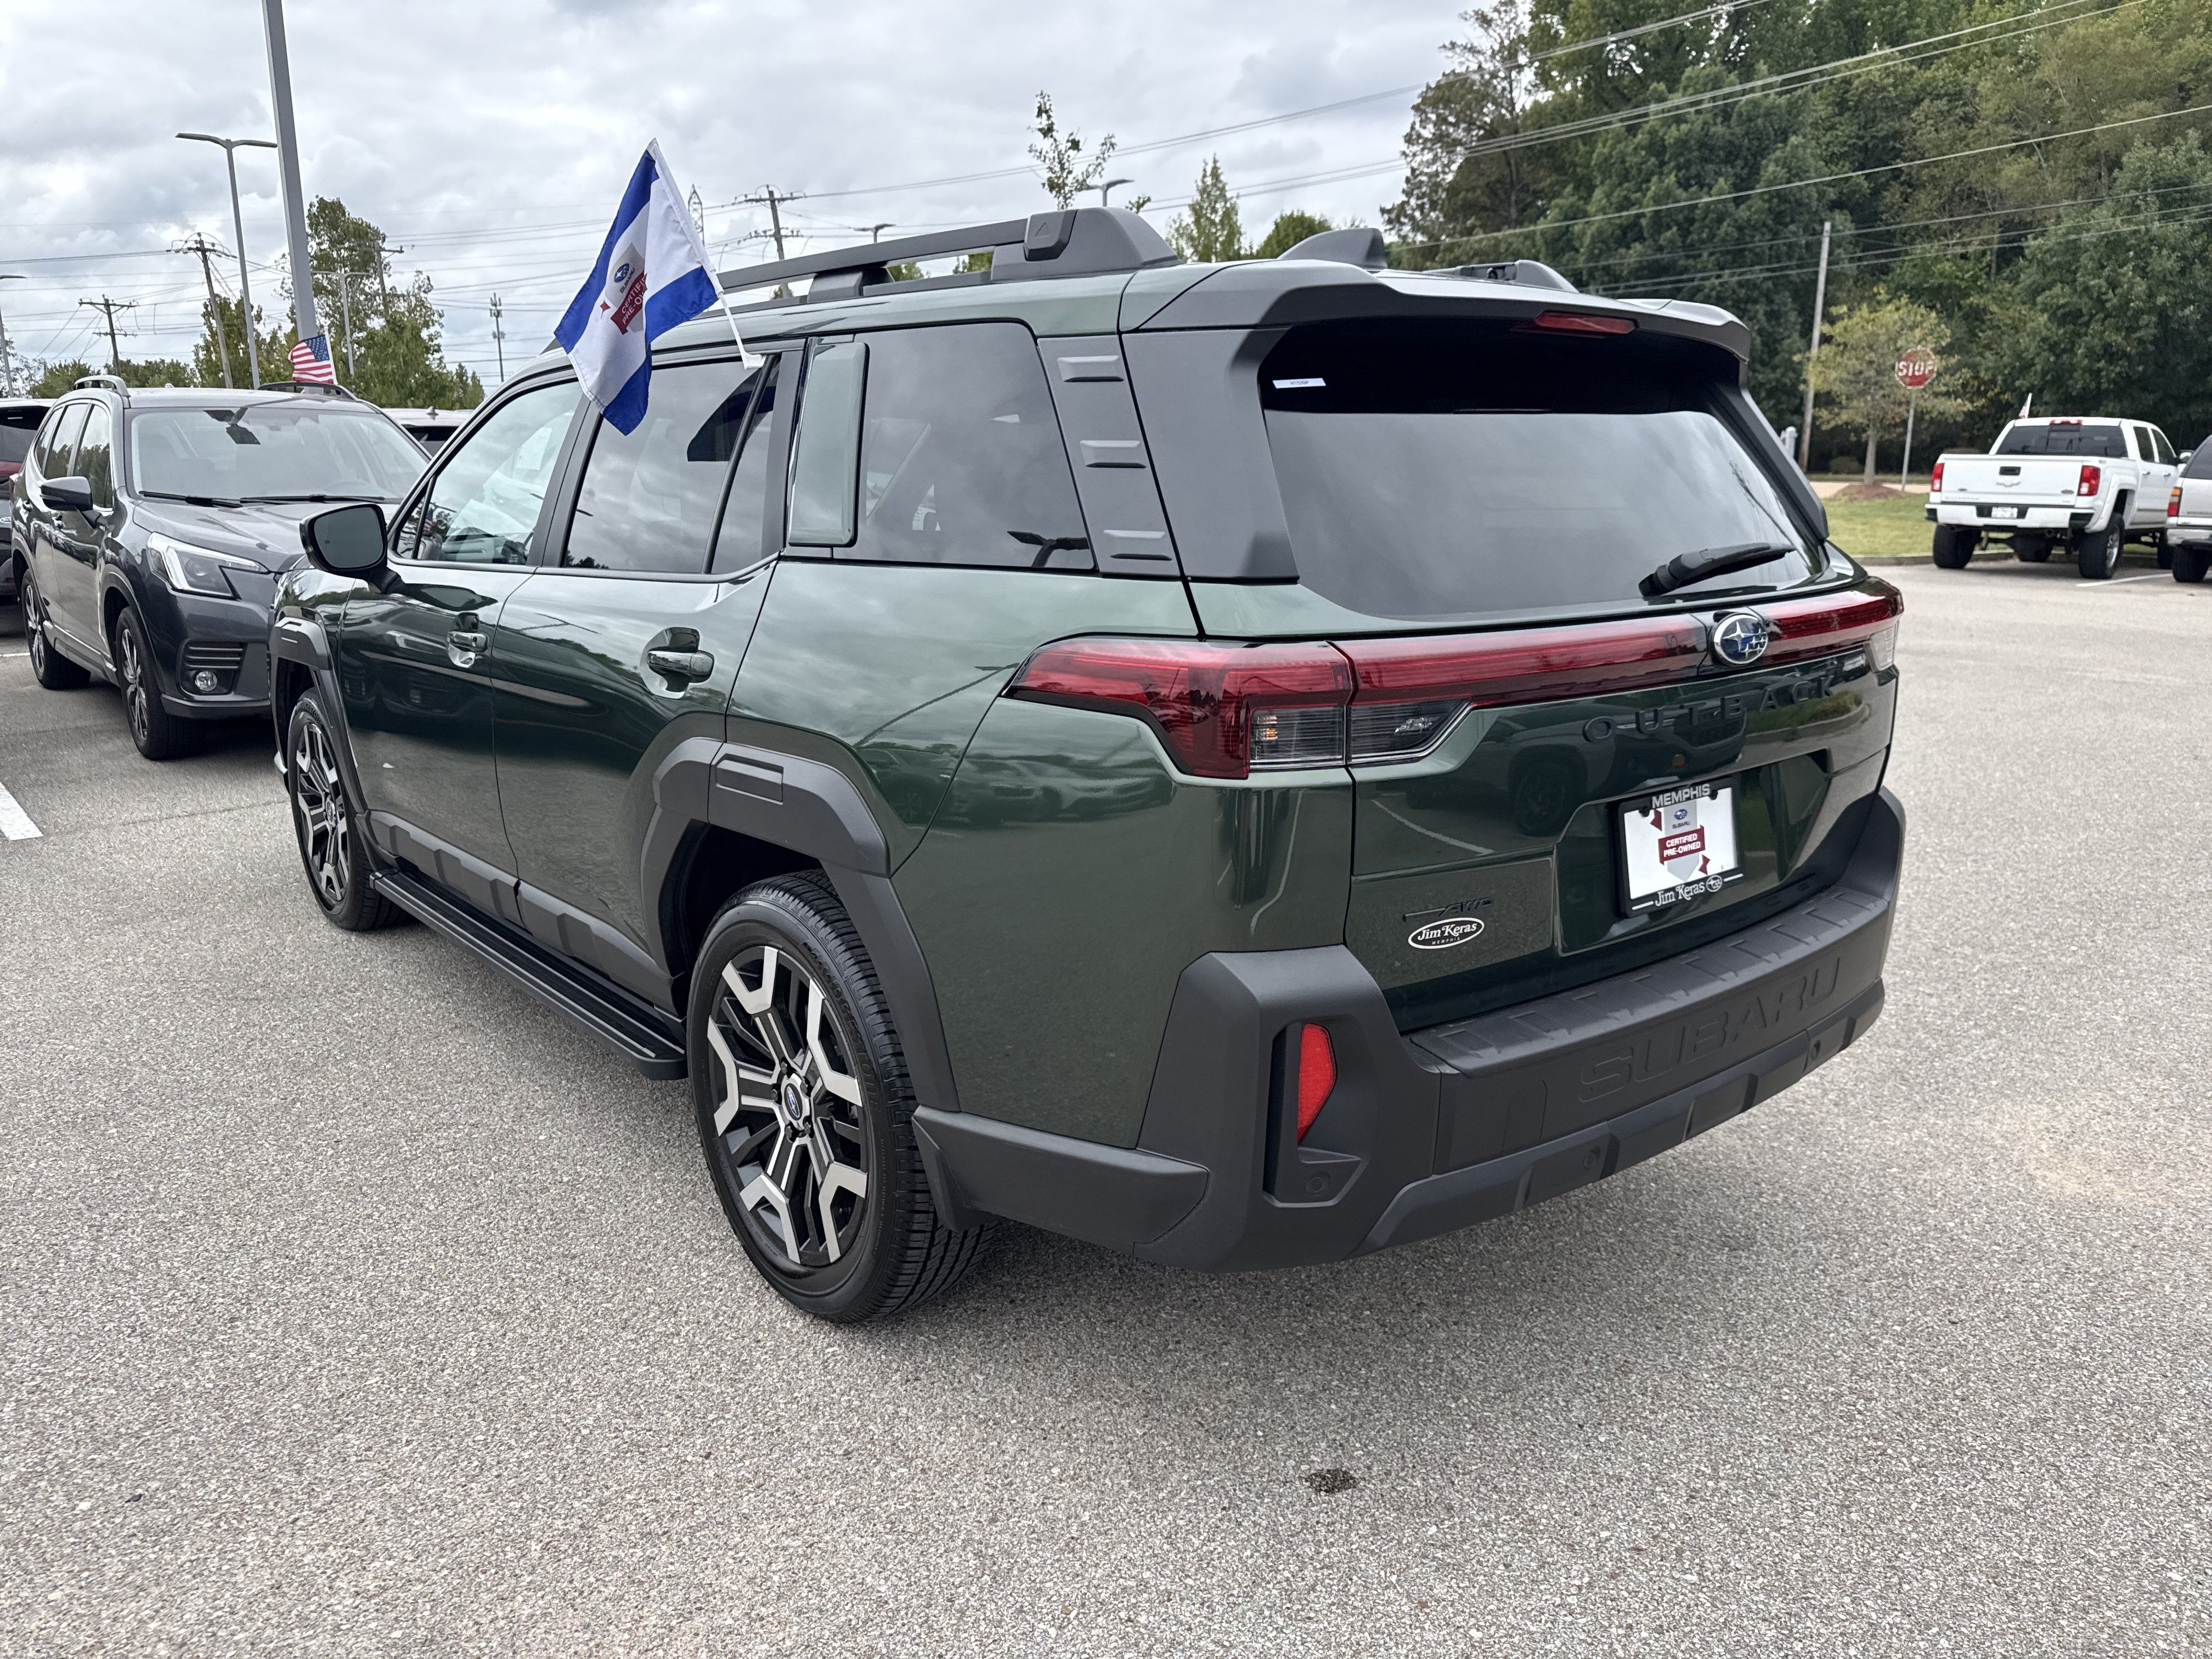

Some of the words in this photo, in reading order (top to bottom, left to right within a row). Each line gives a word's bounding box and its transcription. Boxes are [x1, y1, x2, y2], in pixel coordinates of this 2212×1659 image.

[1898, 360, 1935, 376] STOP
[1583, 674, 1833, 743] OUTBACK
[1652, 783, 1711, 808] MEMPHIS
[1663, 841, 1701, 857] PRE-OWNED
[1666, 833, 1697, 848] CERTIFIED
[1655, 890, 1675, 906] Jim
[1675, 882, 1706, 901] Keras
[1417, 929, 1441, 940] Jim
[1441, 923, 1477, 937] Keras
[1431, 936, 1460, 945] MEMPHIS
[1578, 957, 1841, 1103] SUBARU
